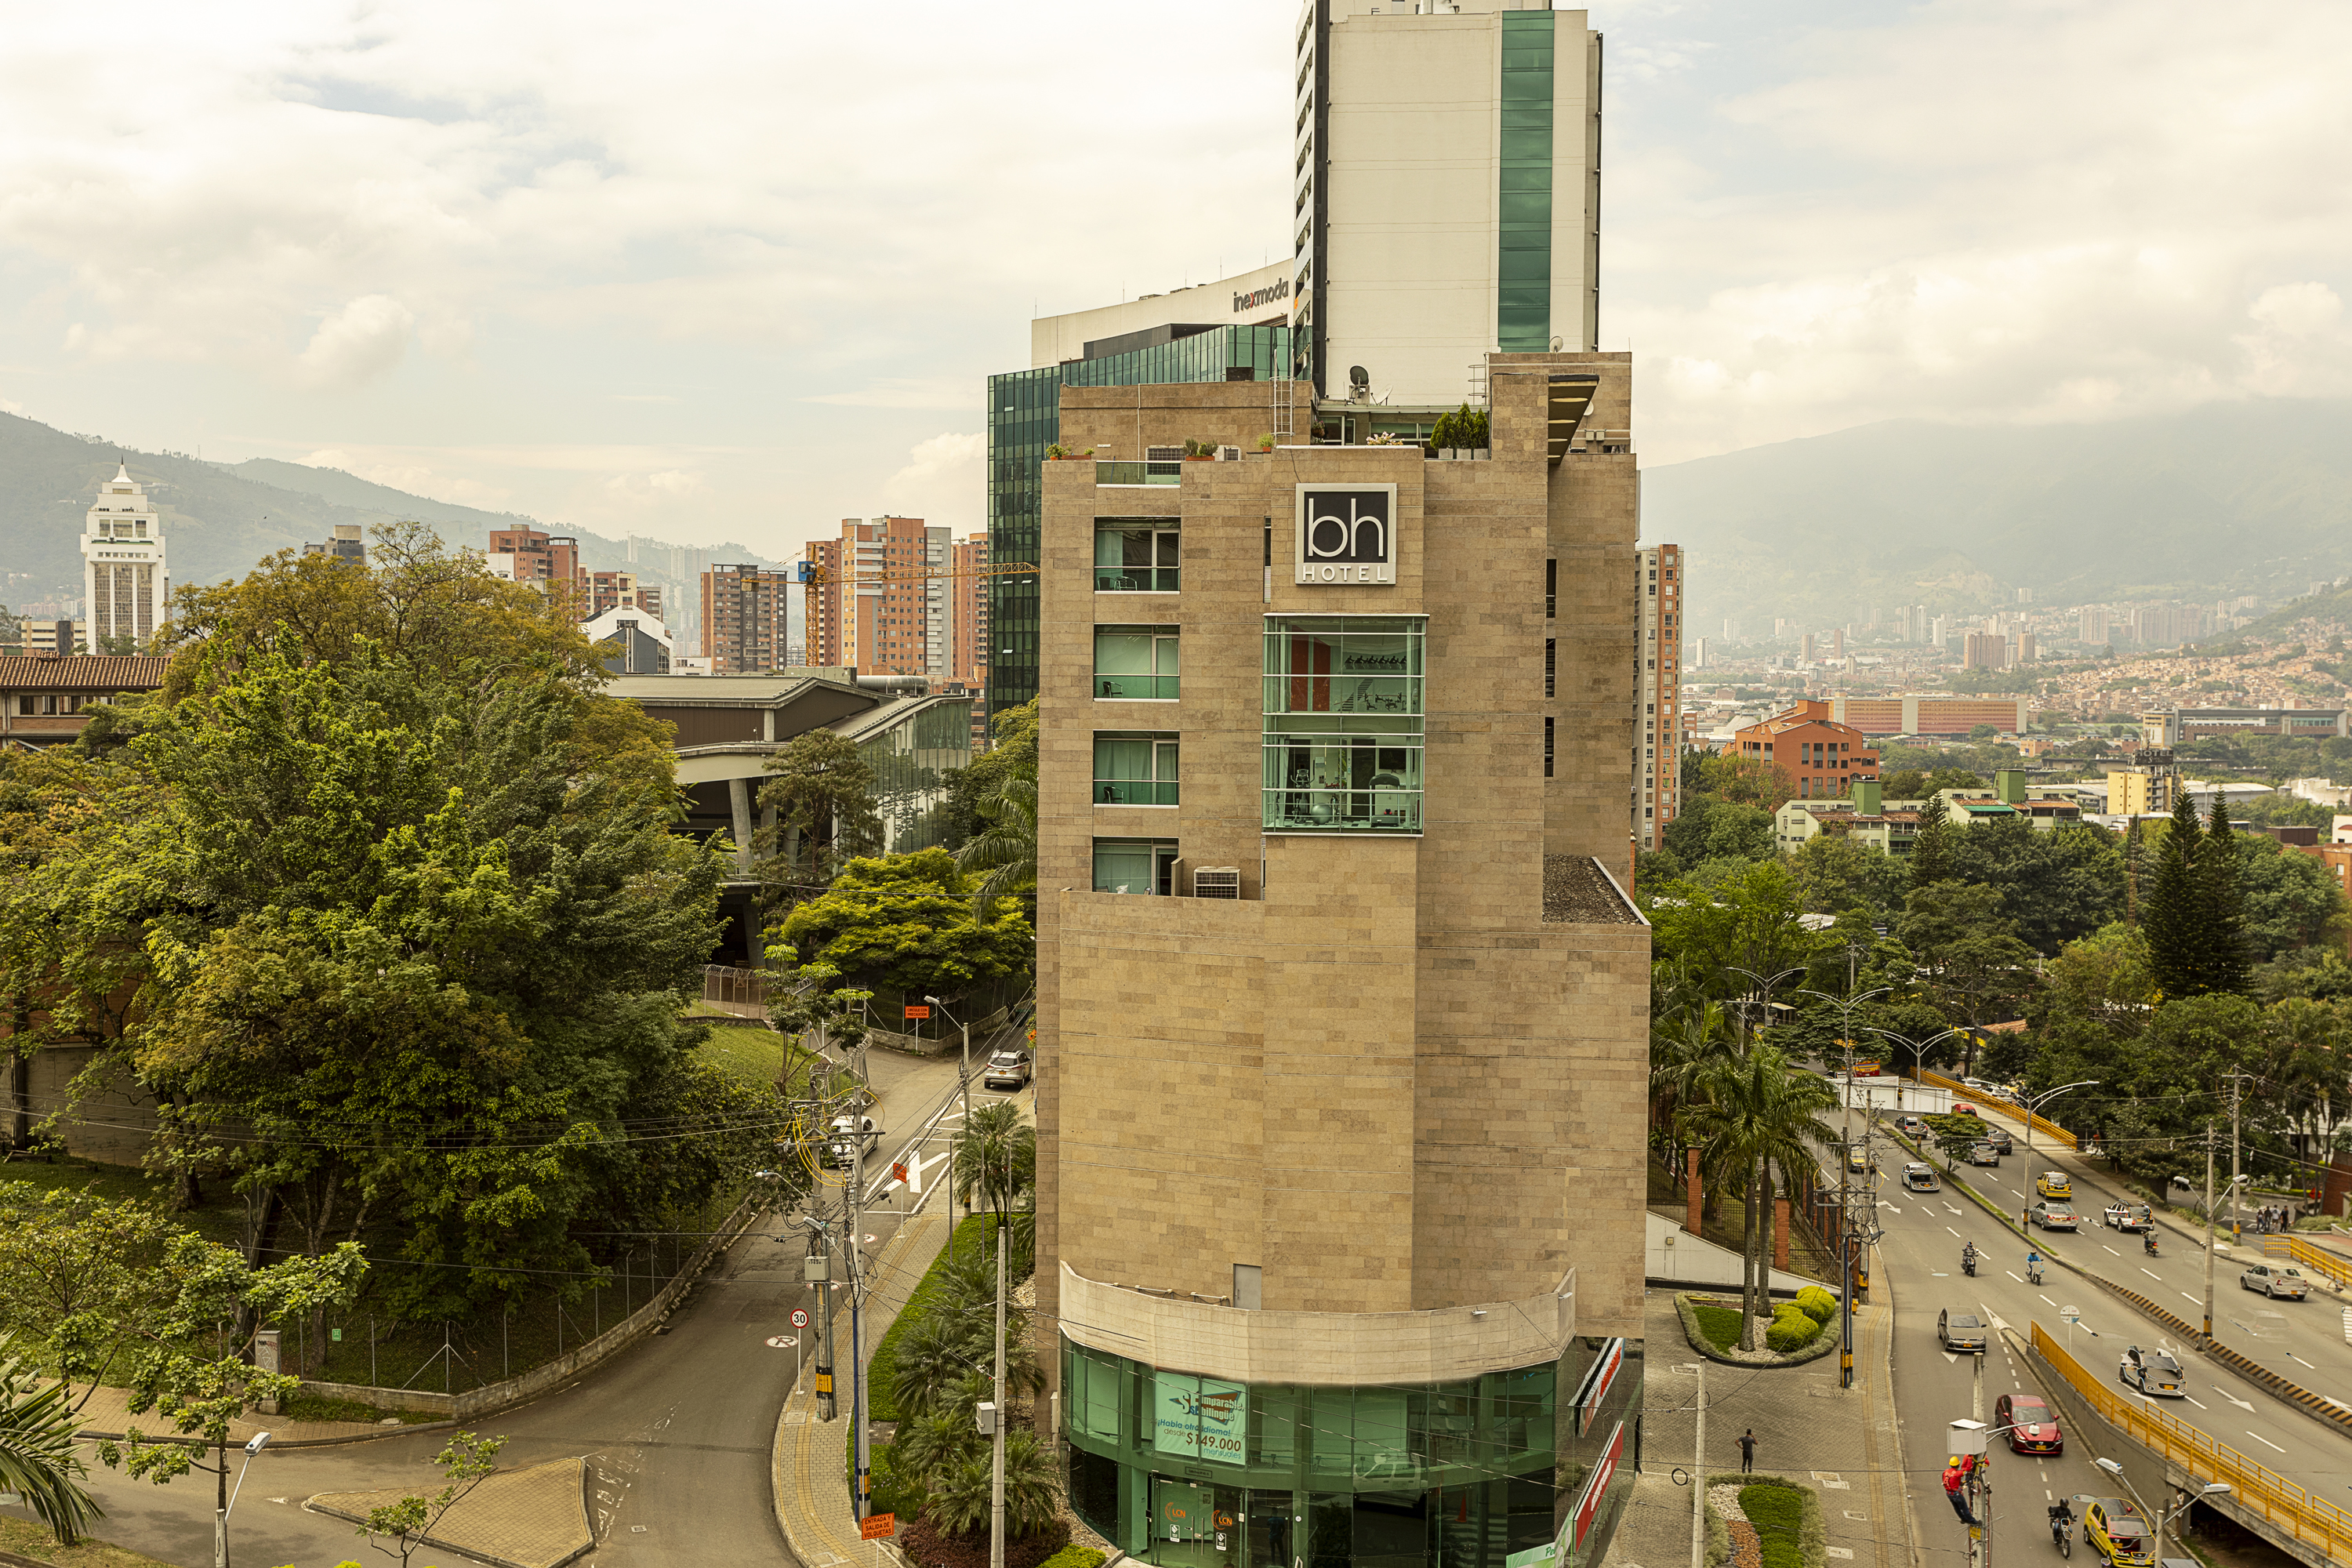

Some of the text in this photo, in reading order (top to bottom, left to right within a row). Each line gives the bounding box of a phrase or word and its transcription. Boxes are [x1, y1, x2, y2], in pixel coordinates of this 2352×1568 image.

[1233, 278, 1288, 313] inexmoda
[1308, 498, 1384, 557] bh
[1302, 565, 1388, 582] HOTEL
[793, 1314, 805, 1323] 30
[1201, 1396, 1245, 1412] imparable,
[1201, 1406, 1235, 1421] bilingüe
[1157, 1419, 1183, 1429] ¡Habla
[1163, 1428, 1185, 1437] desde
[1185, 1432, 1241, 1451] $149.000
[1203, 1448, 1241, 1459] mensuales
[1172, 1508, 1186, 1518] LCN
[1218, 1516, 1232, 1526] LCN
[864, 1528, 891, 1537] VOLQUETAS
